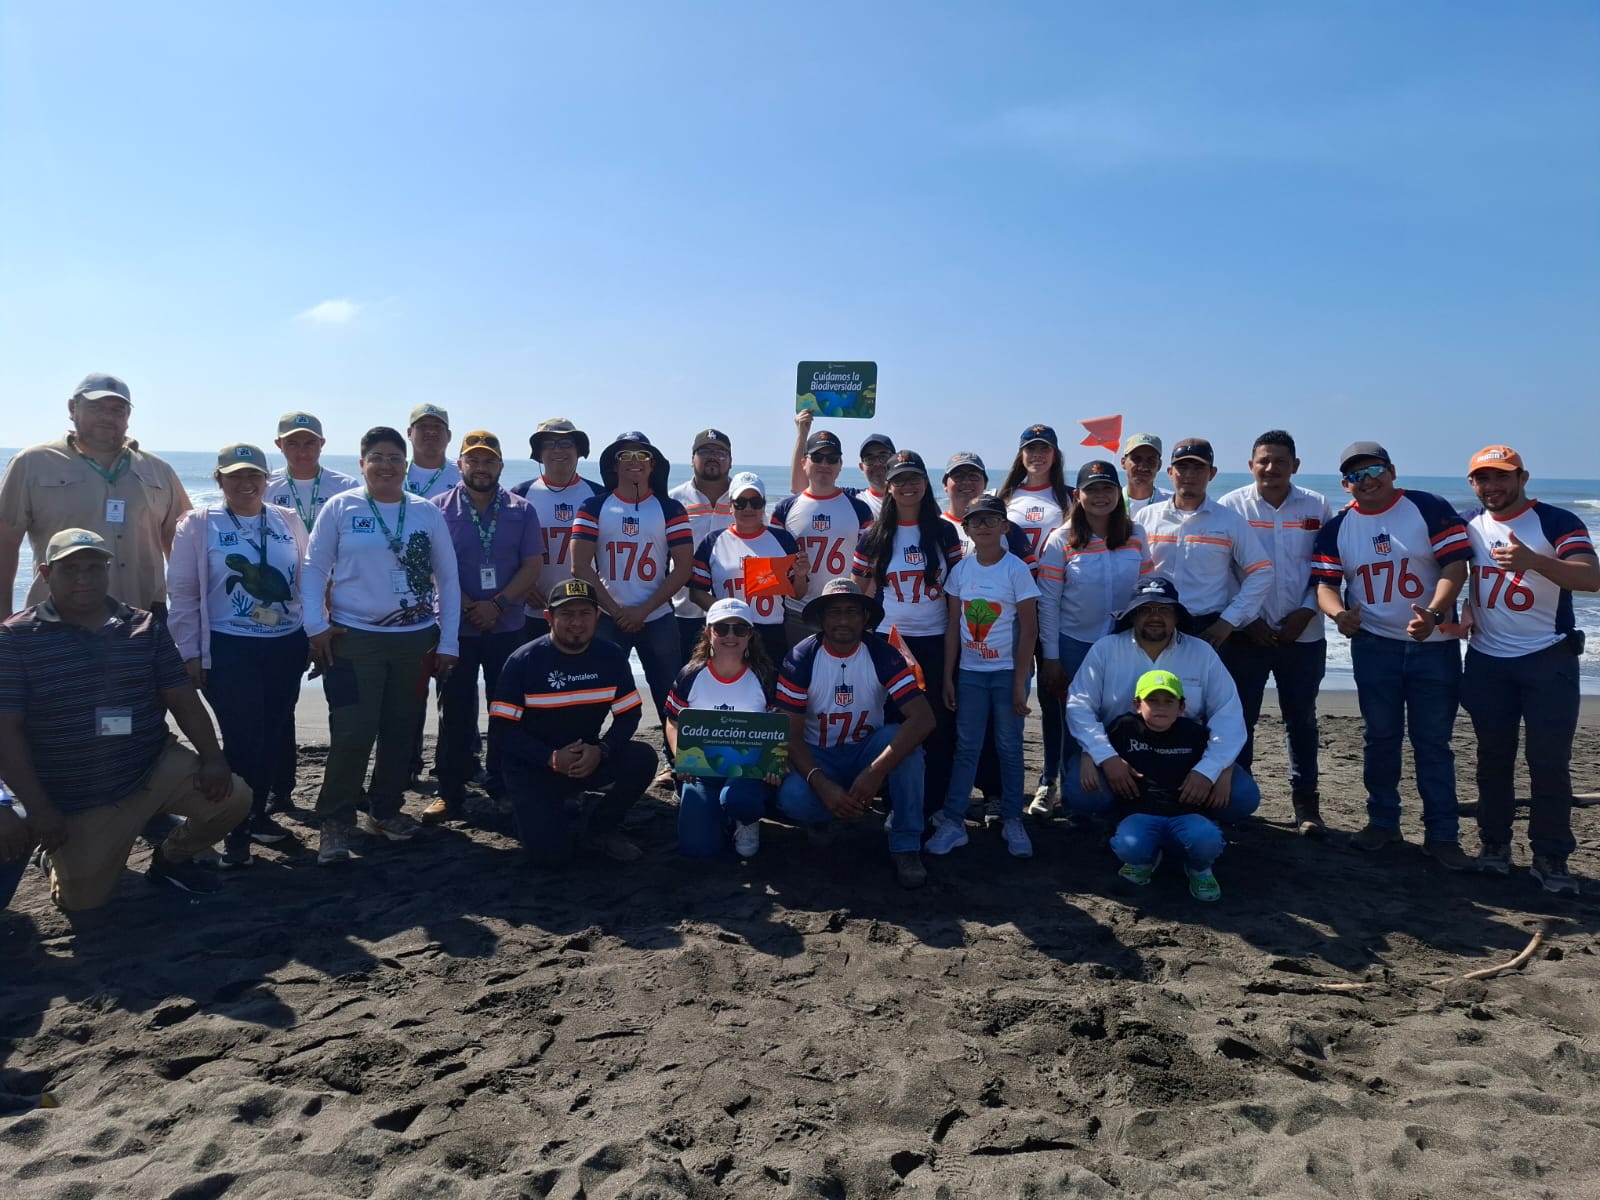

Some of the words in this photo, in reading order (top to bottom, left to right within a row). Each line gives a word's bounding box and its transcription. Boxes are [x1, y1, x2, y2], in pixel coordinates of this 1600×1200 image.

[811, 381, 862, 391] Biodiversidad
[813, 372, 850, 381] Cuidamos
[852, 372, 860, 381] la
[606, 541, 656, 581] 176
[568, 583, 586, 592] CAT
[886, 568, 943, 603] 176
[1357, 558, 1424, 604] 176
[1472, 565, 1535, 611] 176
[567, 673, 599, 681] Pantaleon
[681, 725, 709, 736] Cada
[711, 727, 746, 739] acción
[748, 729, 785, 741] cuenta
[817, 711, 874, 748] 176
